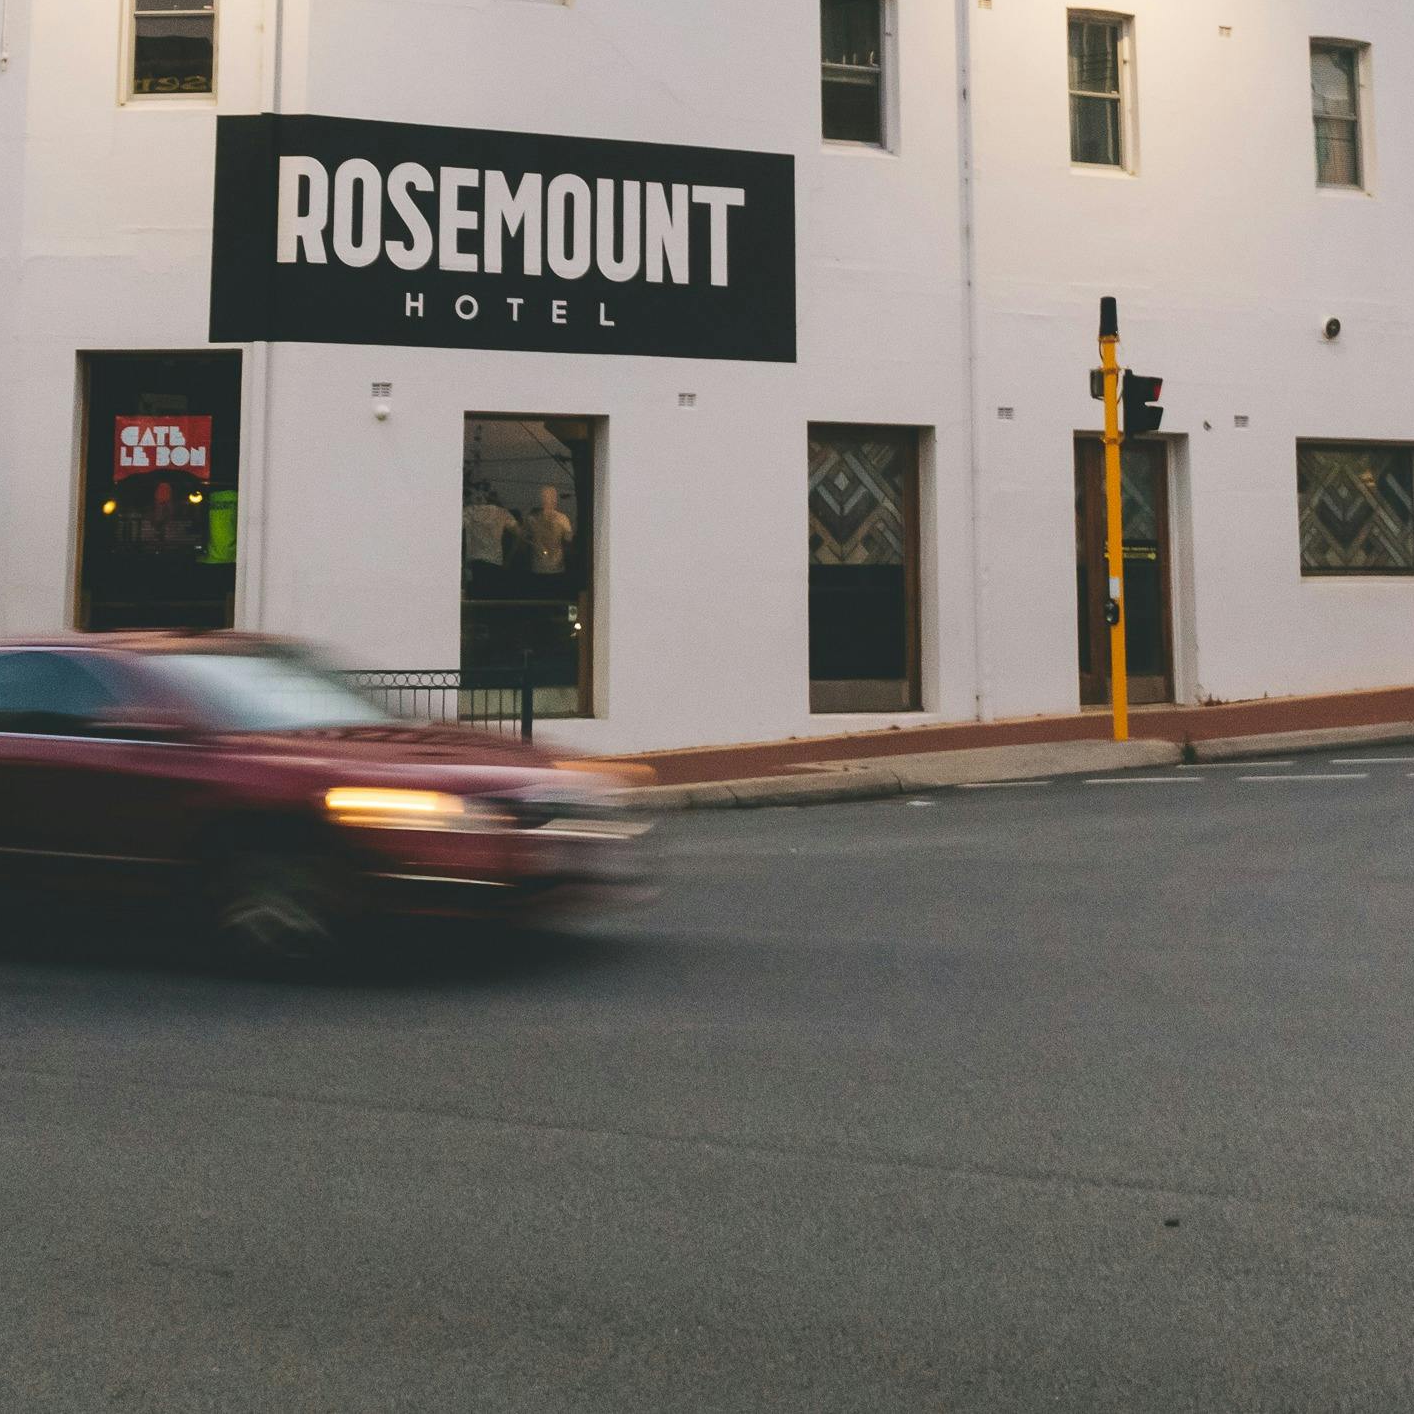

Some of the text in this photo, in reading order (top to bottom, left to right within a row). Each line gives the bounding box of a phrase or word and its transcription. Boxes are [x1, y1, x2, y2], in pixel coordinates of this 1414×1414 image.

[276, 154, 746, 288] ROSEMOUNT
[404, 291, 616, 328] HOTEL
[119, 425, 186, 447] CATE
[119, 445, 206, 467] LE BON
